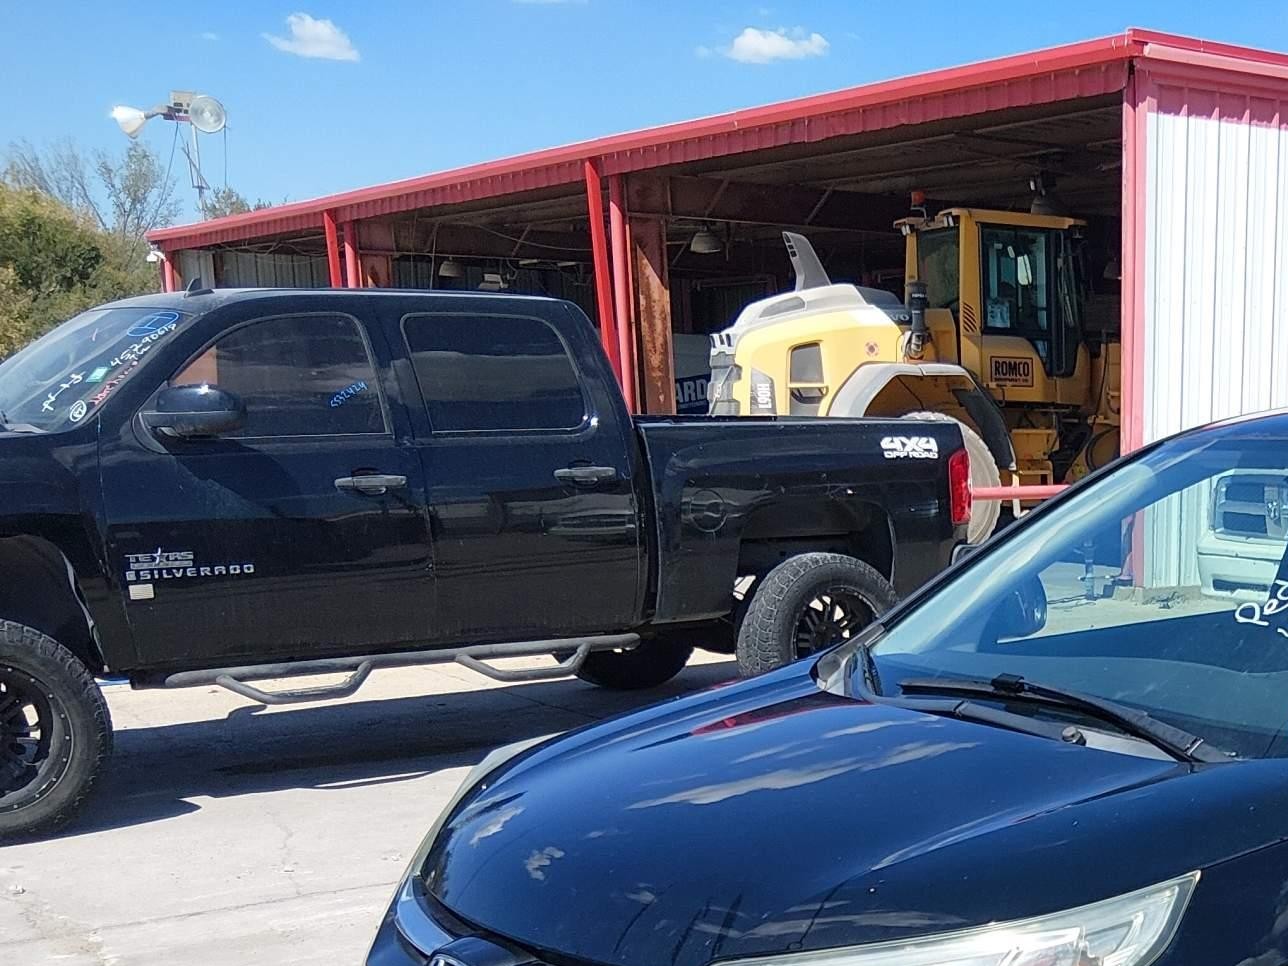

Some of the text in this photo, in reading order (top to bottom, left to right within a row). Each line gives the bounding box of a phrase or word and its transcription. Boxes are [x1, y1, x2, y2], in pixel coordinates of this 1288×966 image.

[994, 360, 1030, 378] ROMCO
[757, 383, 772, 409] L90H
[884, 451, 938, 459] OFF ROAD
[124, 547, 194, 565] TEXAS
[139, 563, 255, 580] SILVERADO
